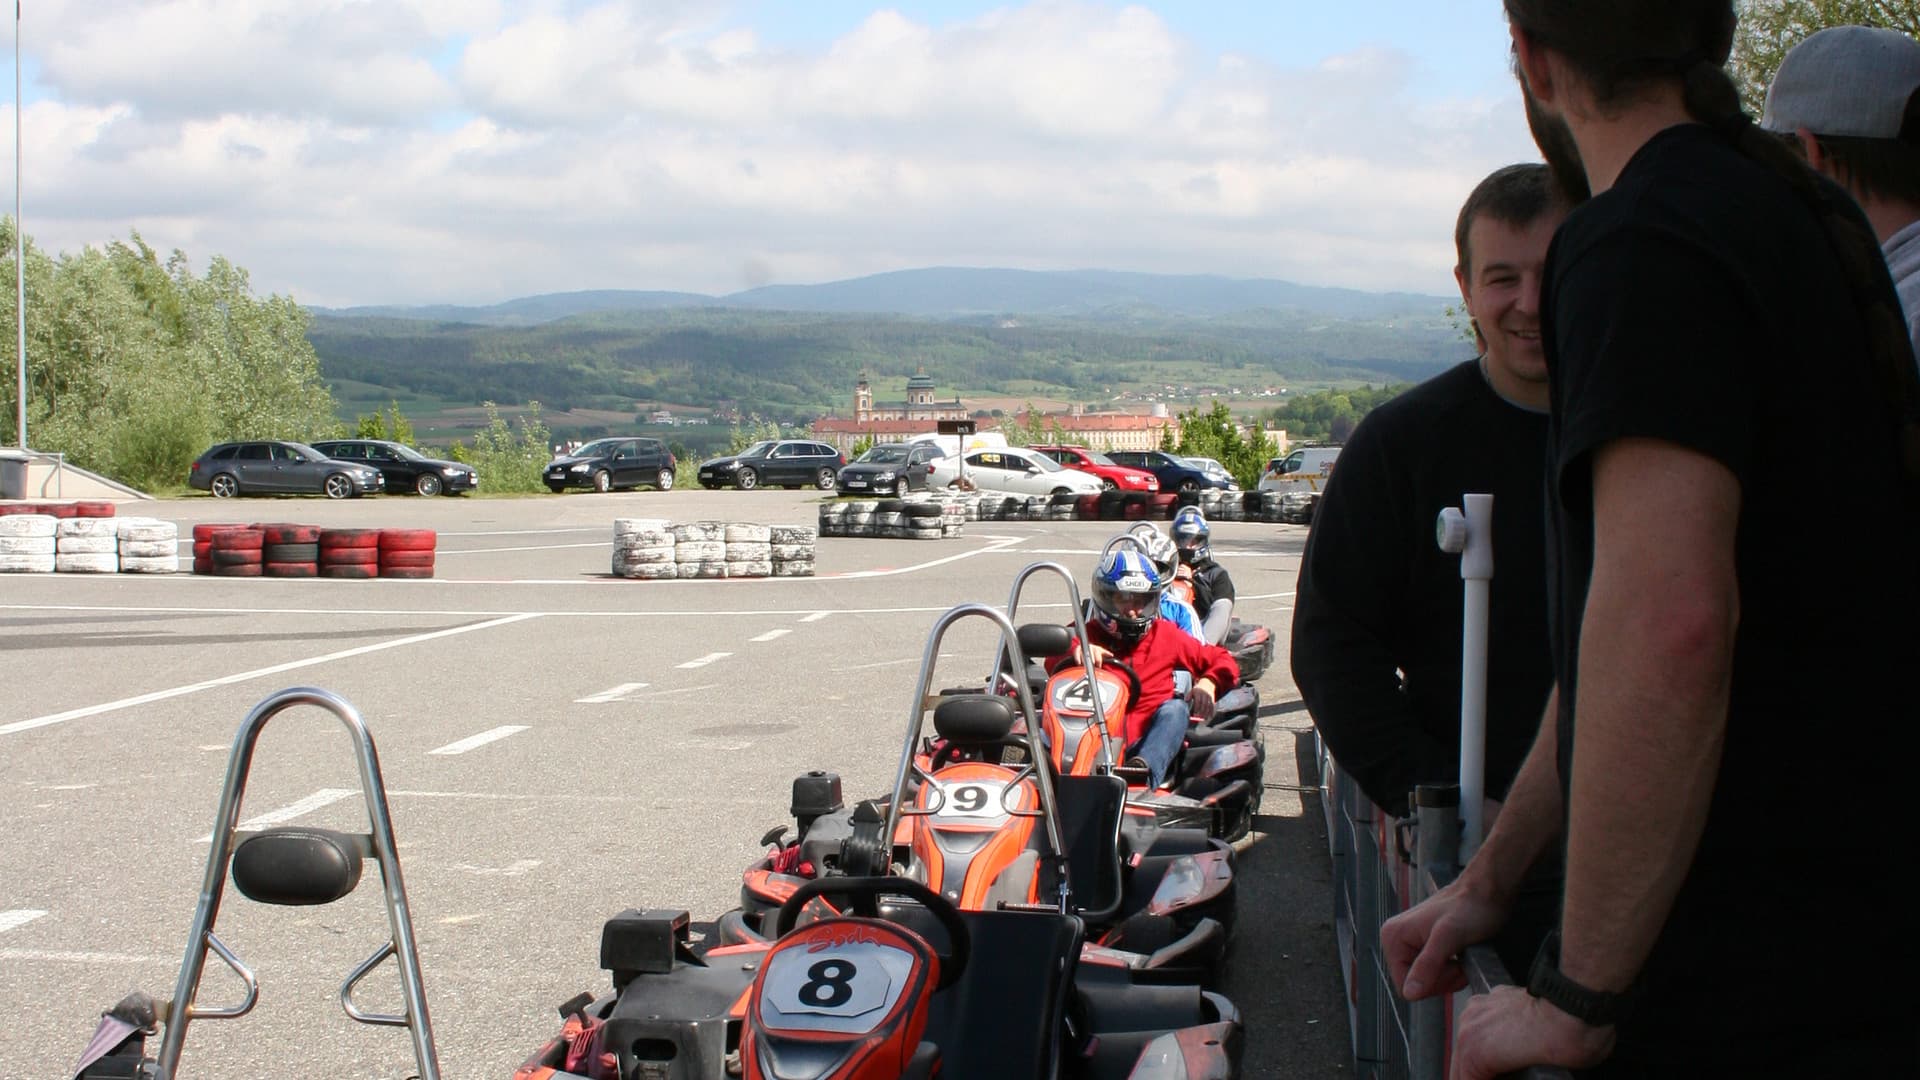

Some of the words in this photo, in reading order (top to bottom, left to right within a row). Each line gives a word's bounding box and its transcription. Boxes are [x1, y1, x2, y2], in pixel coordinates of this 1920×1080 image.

[1065, 683, 1093, 702] 4
[952, 786, 989, 812] 9
[798, 959, 857, 1008] 8
